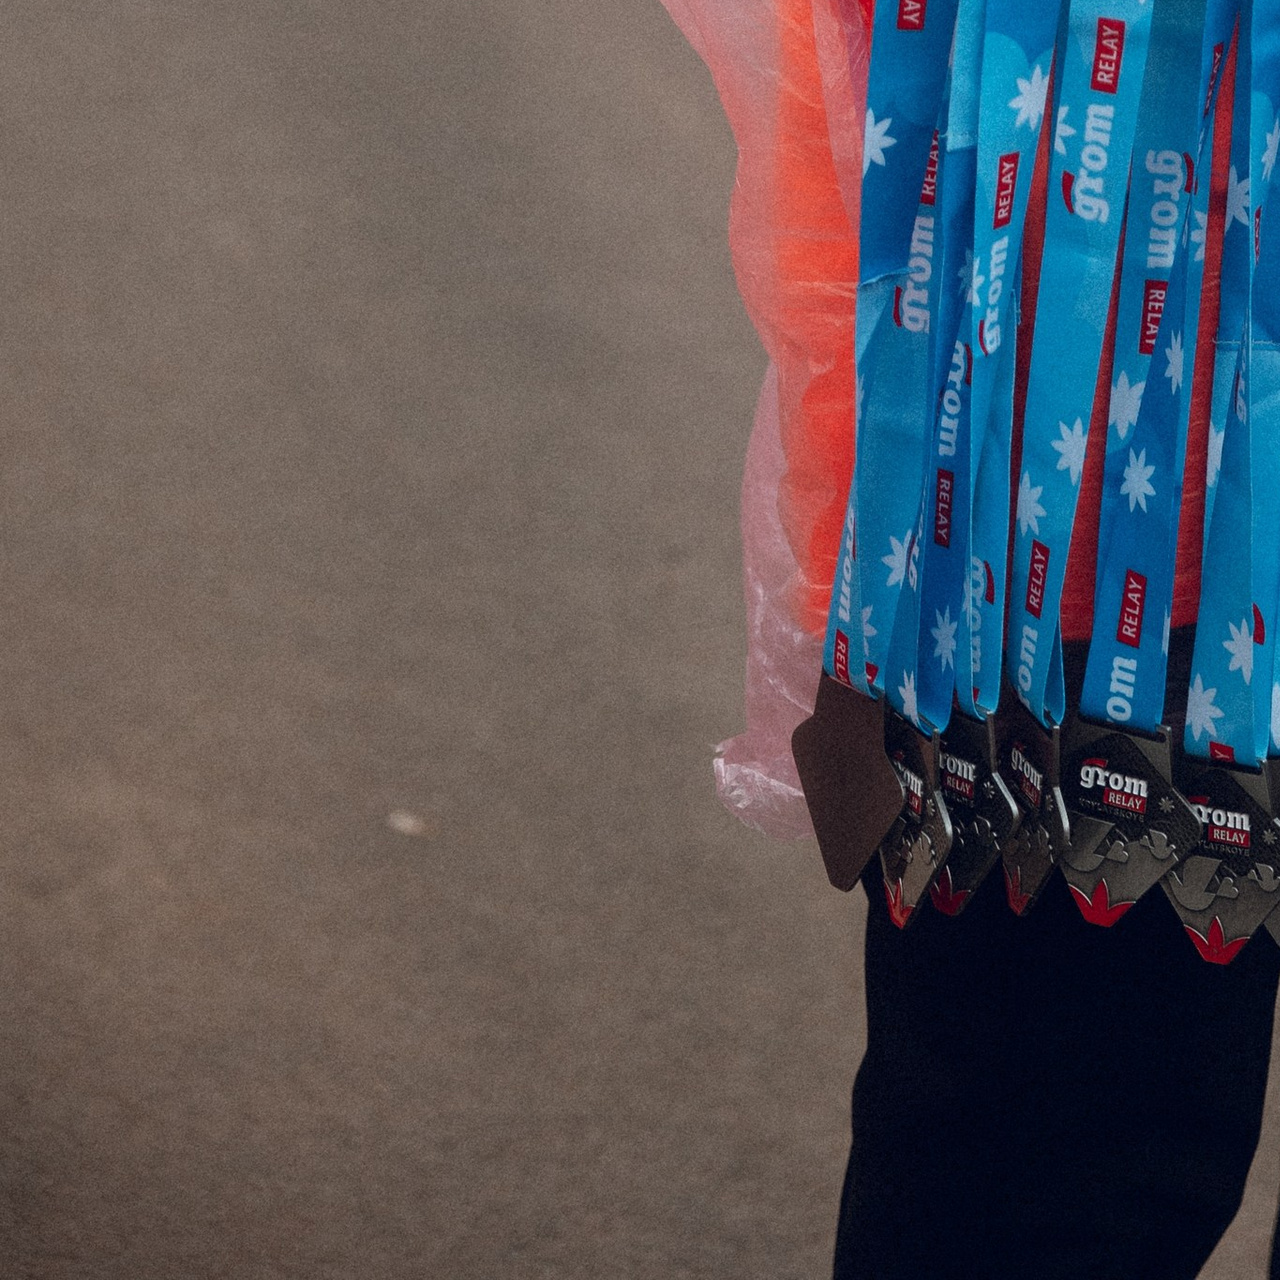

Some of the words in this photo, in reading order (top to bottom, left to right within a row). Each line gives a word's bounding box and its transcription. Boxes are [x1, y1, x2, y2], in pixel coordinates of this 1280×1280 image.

[1074, 103, 1116, 224] grom
[1096, 24, 1119, 86] RELAY
[1144, 148, 1184, 269] grom
[902, 215, 934, 334] grom
[984, 235, 1010, 355] grom
[997, 160, 1016, 221] RELAY
[936, 477, 953, 541] RELAY
[1027, 547, 1049, 609] RELAY
[1121, 576, 1143, 639] RELAY
[946, 775, 971, 795] RELAY
[1011, 747, 1043, 791] grom
[1079, 764, 1149, 798] grom
[1108, 791, 1143, 810] RELAY
[1212, 828, 1246, 845] RELAY
